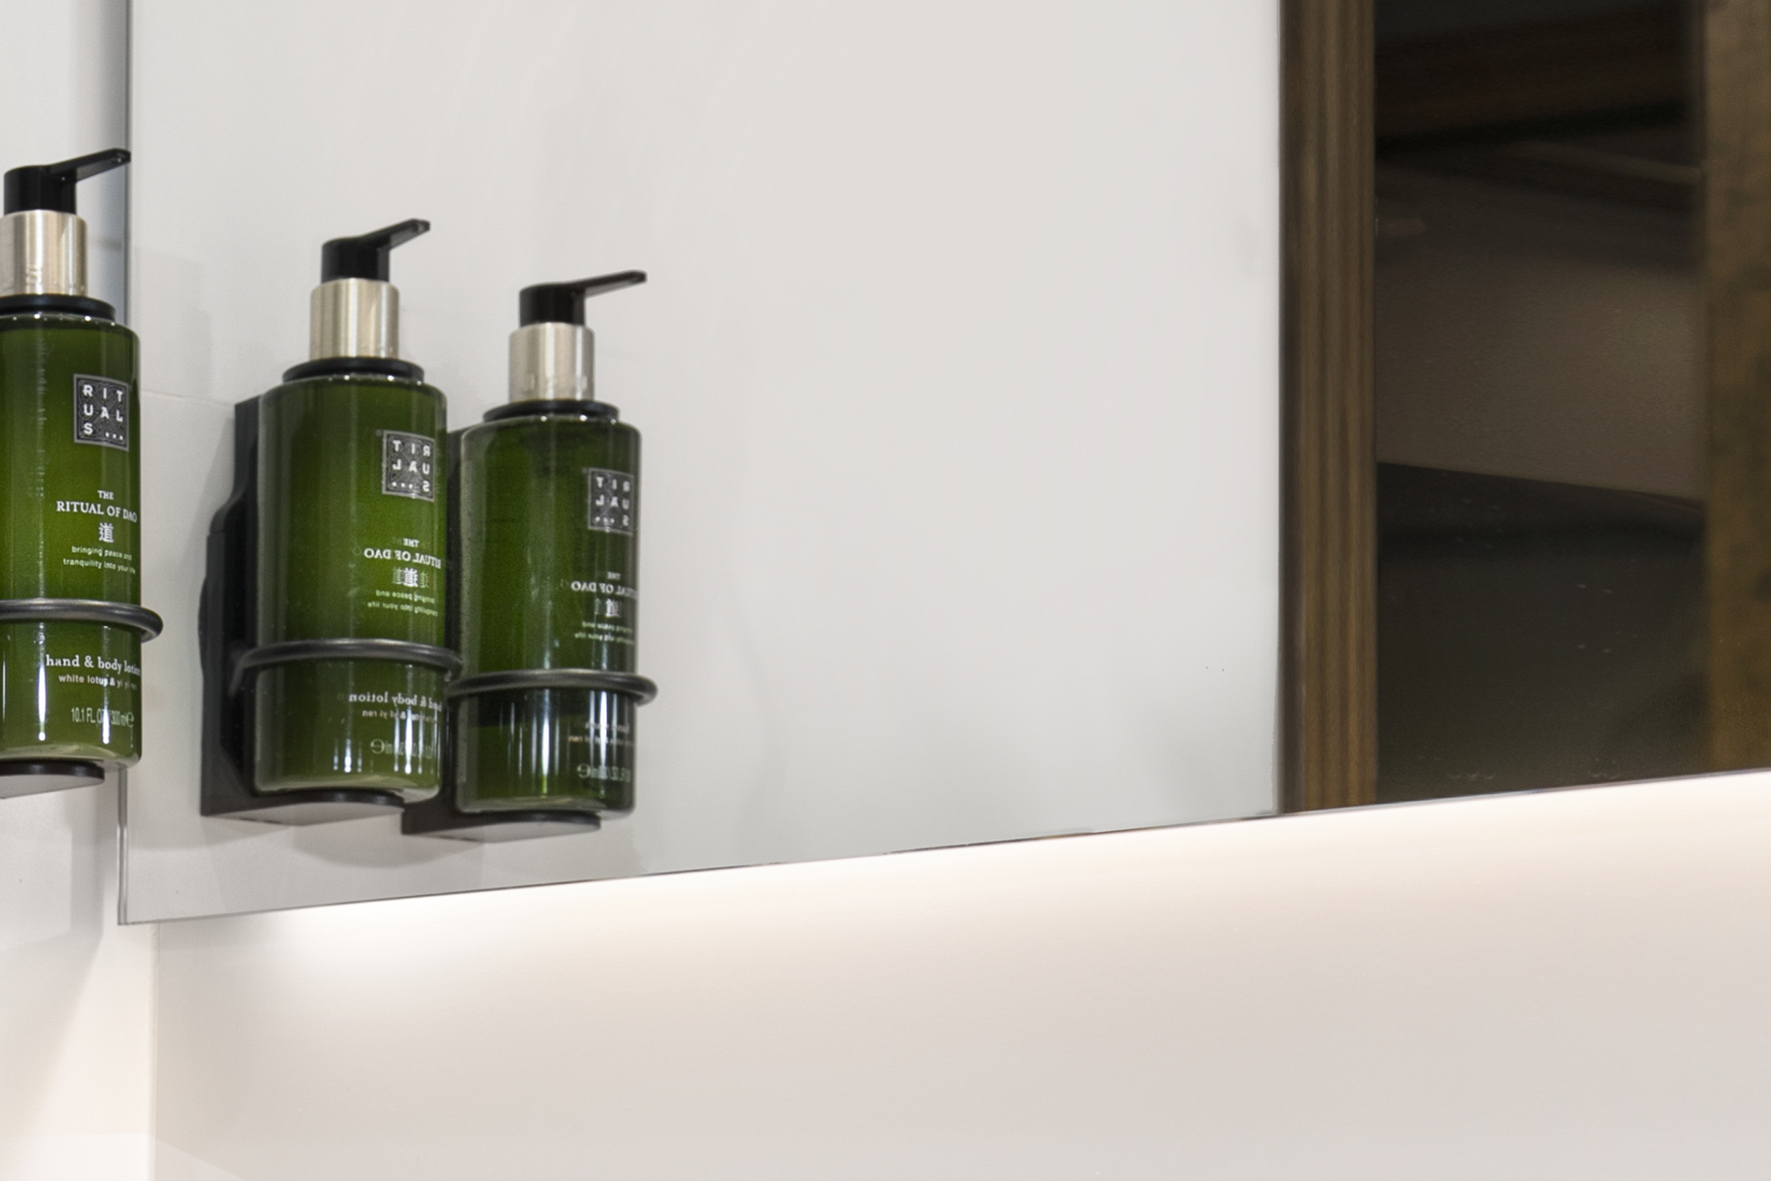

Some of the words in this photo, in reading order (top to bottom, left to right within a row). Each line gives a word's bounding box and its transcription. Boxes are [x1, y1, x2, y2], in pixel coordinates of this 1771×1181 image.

[97, 490, 114, 500] THE
[56, 501, 104, 515] RITUAL
[107, 505, 121, 518] OF
[122, 508, 138, 523] DAO
[71, 545, 103, 557] bringing
[104, 549, 122, 557] peace
[62, 558, 102, 569] tranquility
[103, 561, 117, 570] into
[46, 654, 80, 667] hand
[84, 655, 94, 668] &
[97, 656, 122, 675] body
[58, 674, 85, 683] white
[109, 677, 116, 686] &
